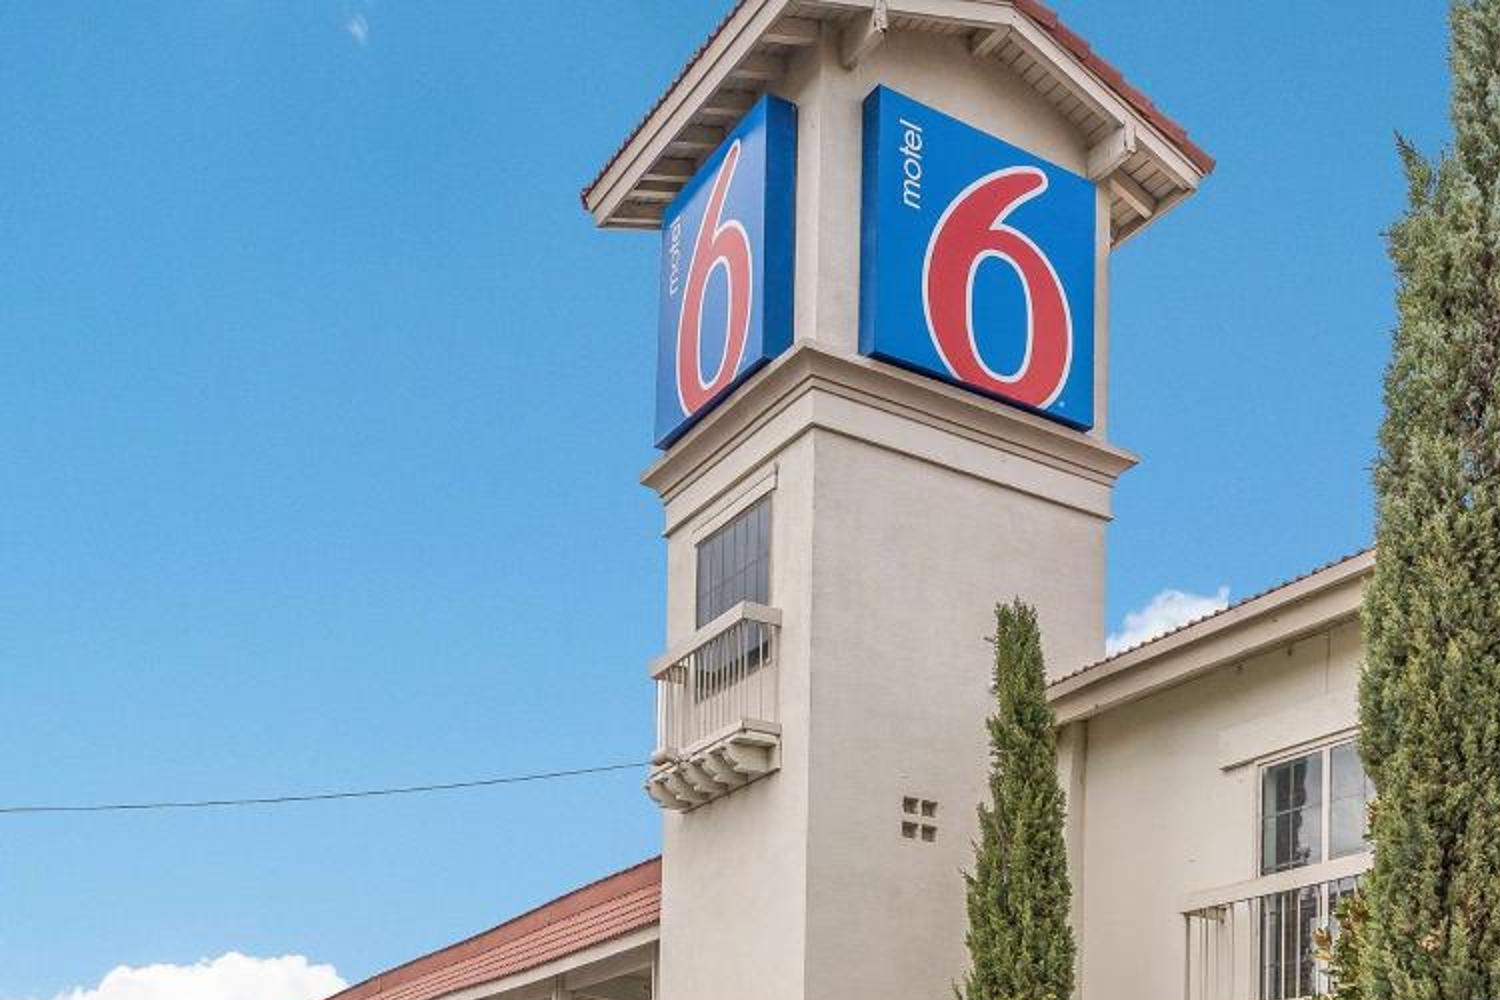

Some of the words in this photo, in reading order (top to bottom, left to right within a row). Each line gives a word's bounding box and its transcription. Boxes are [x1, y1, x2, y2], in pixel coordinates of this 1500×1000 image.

[676, 138, 753, 417] 6
[899, 118, 924, 210] motel
[921, 165, 1073, 409] 6
